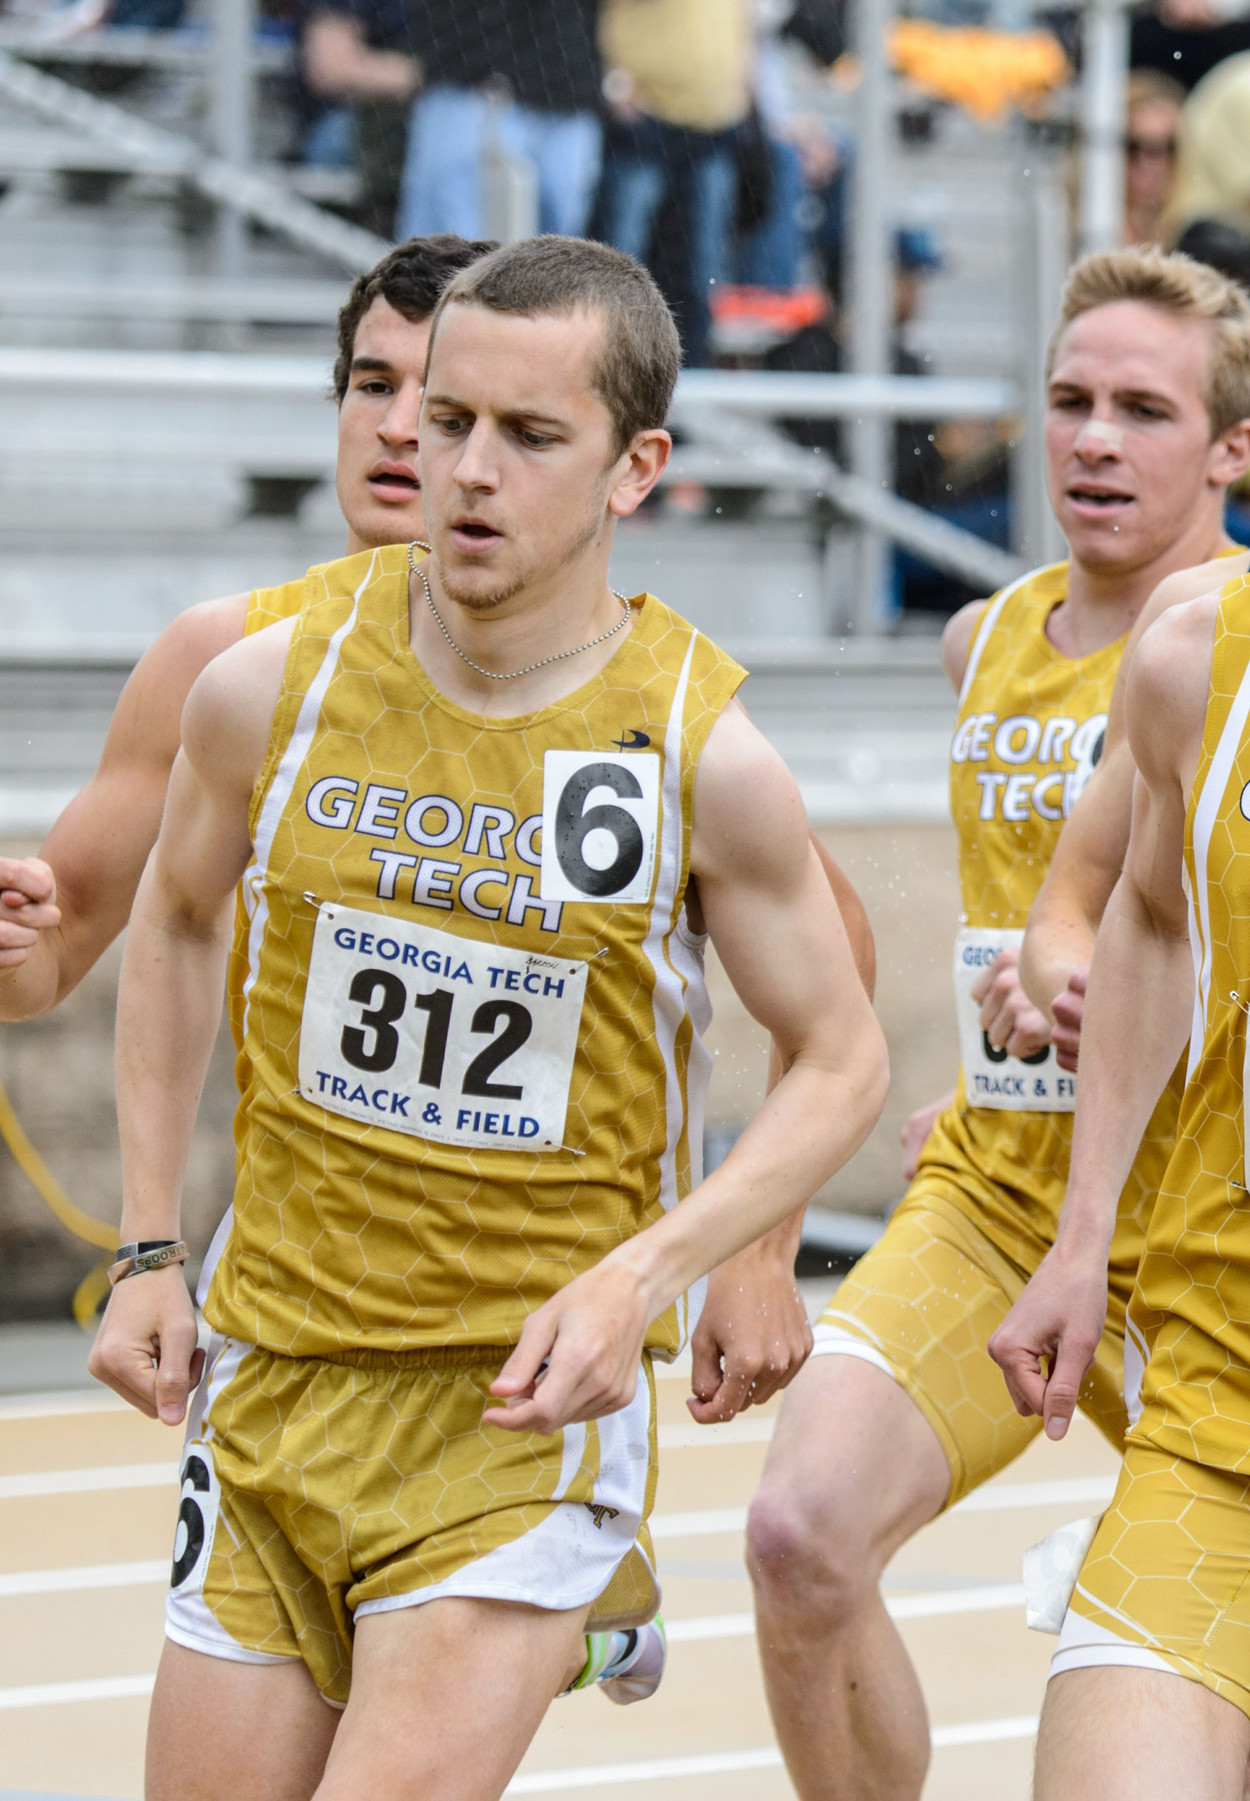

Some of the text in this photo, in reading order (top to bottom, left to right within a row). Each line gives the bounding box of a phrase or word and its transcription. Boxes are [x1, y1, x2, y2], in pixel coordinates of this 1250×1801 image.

[555, 762, 644, 897] 6
[369, 848, 564, 933] TECH
[334, 928, 473, 984] GEORGIA
[487, 966, 565, 998] TECH
[341, 968, 532, 1100] 312
[316, 1070, 411, 1117] TRACK
[422, 1102, 442, 1125] &
[456, 1109, 539, 1138] FIELD
[974, 1075, 1024, 1096] TRACK
[1035, 1078, 1047, 1096] &
[171, 1455, 210, 1588] 6
